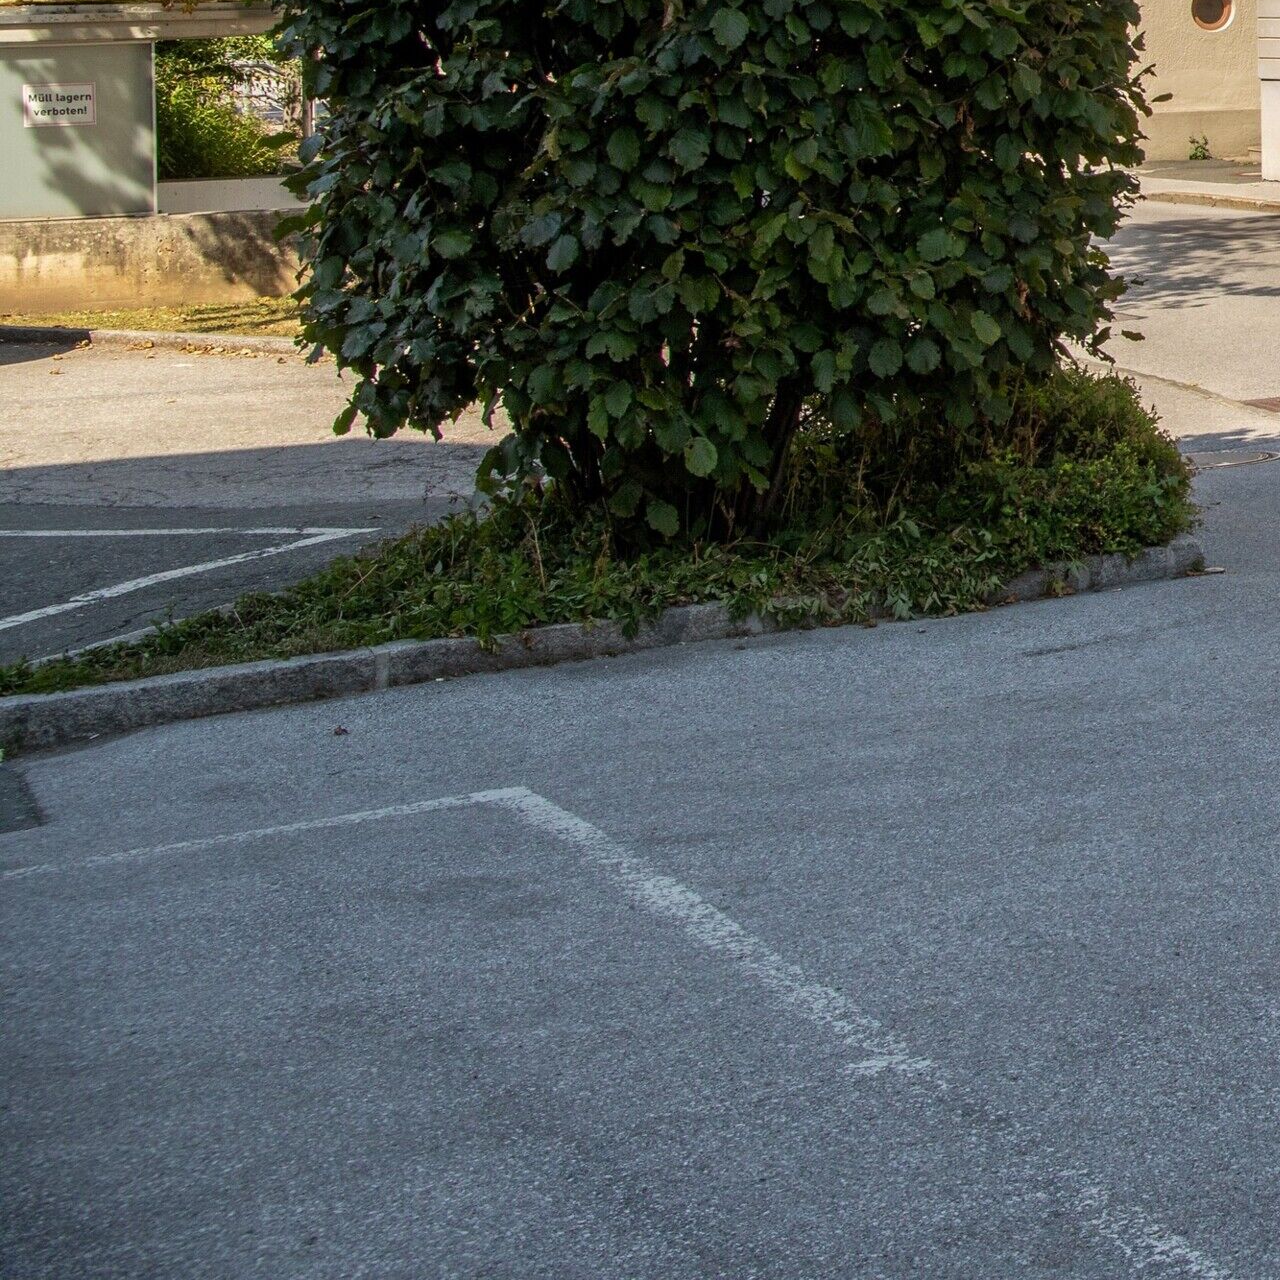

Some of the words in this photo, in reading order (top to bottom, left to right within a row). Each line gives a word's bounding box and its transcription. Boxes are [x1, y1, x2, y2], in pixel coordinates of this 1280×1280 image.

[28, 93, 52, 102] Müll
[55, 93, 92, 104] lagern
[34, 106, 87, 116] verboten!
